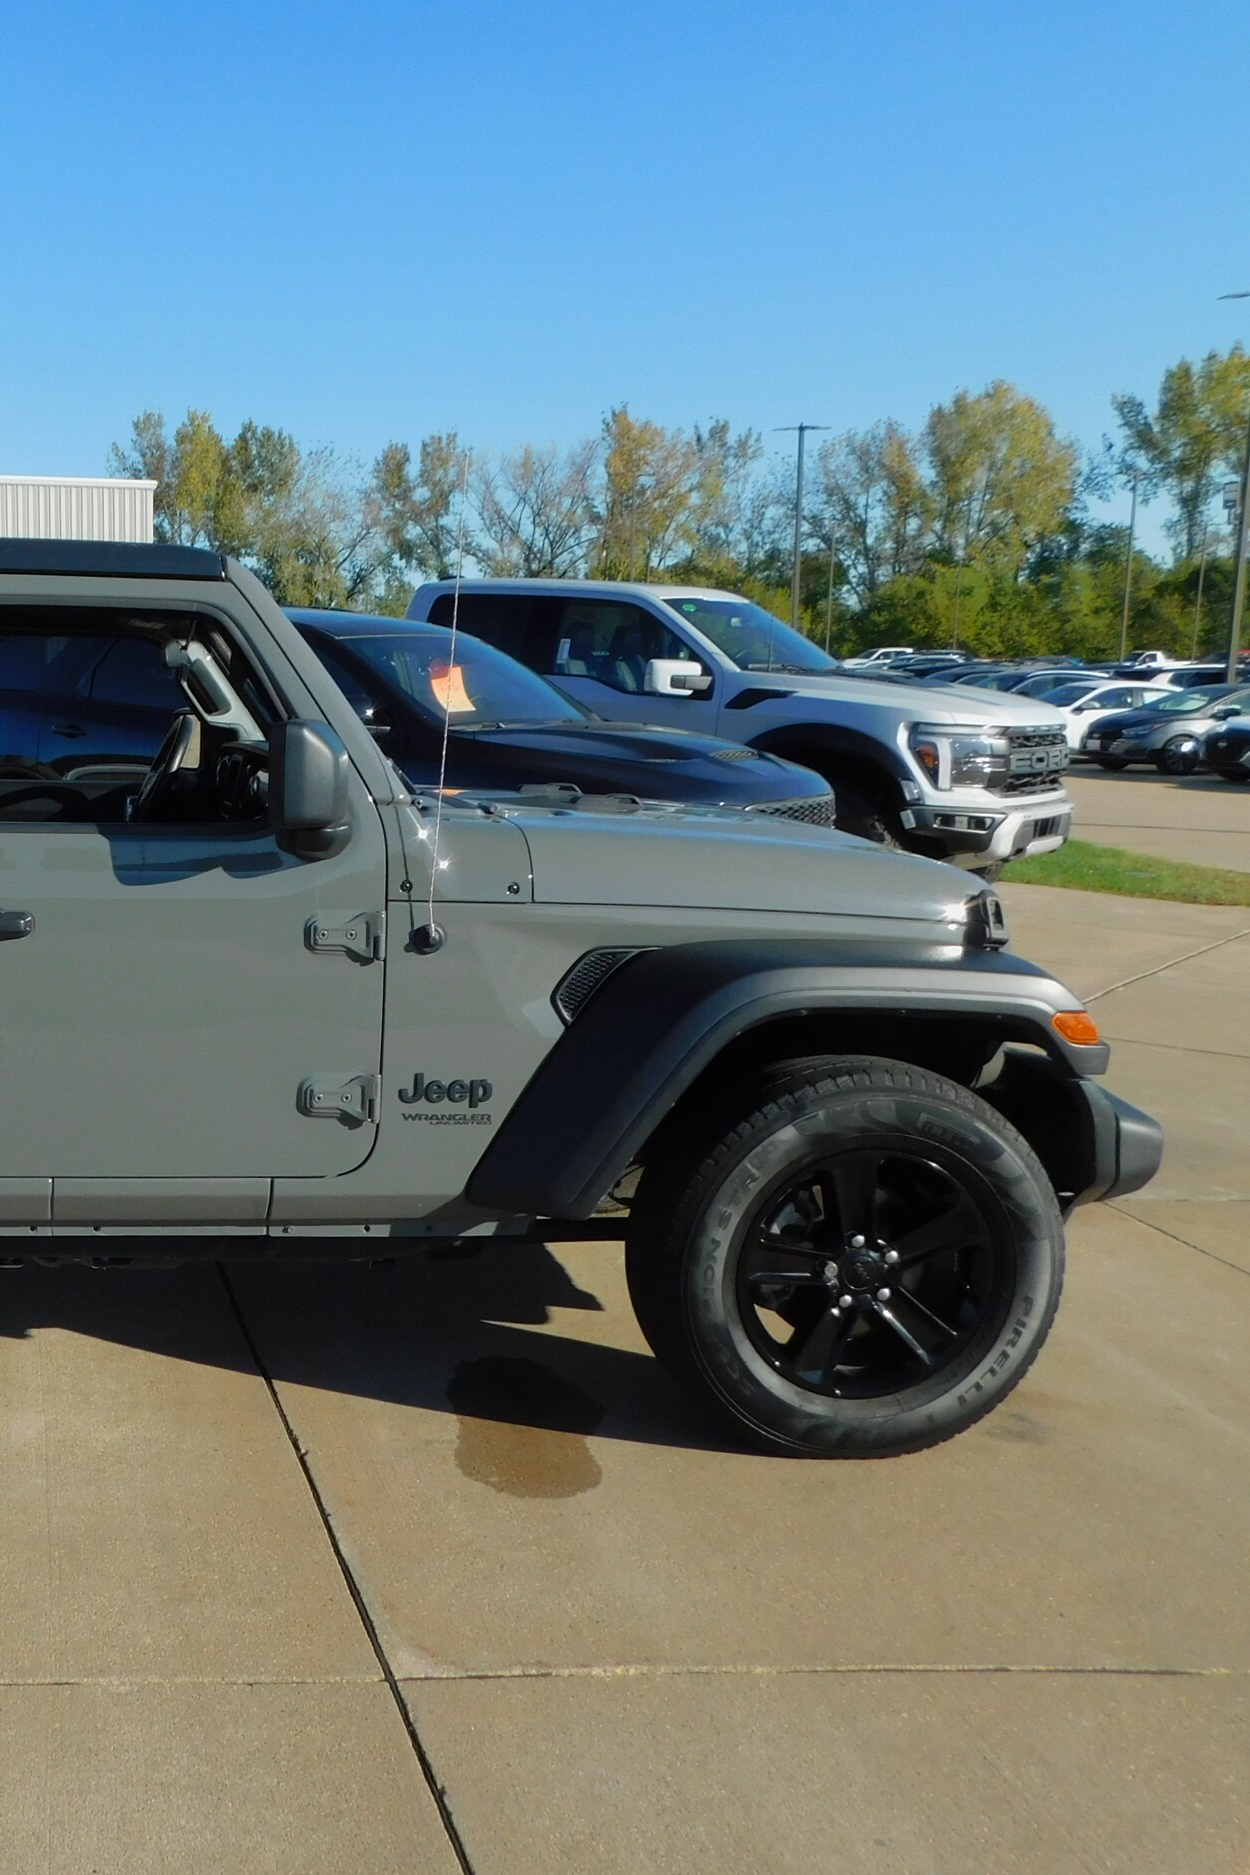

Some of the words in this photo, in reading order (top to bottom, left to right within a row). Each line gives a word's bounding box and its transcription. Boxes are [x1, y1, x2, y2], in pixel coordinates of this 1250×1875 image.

[1010, 749, 1070, 772] FORD
[398, 1072, 493, 1108] Jeep
[401, 1113, 492, 1122] WRANGLER
[957, 1295, 1034, 1406] PIRELLI
